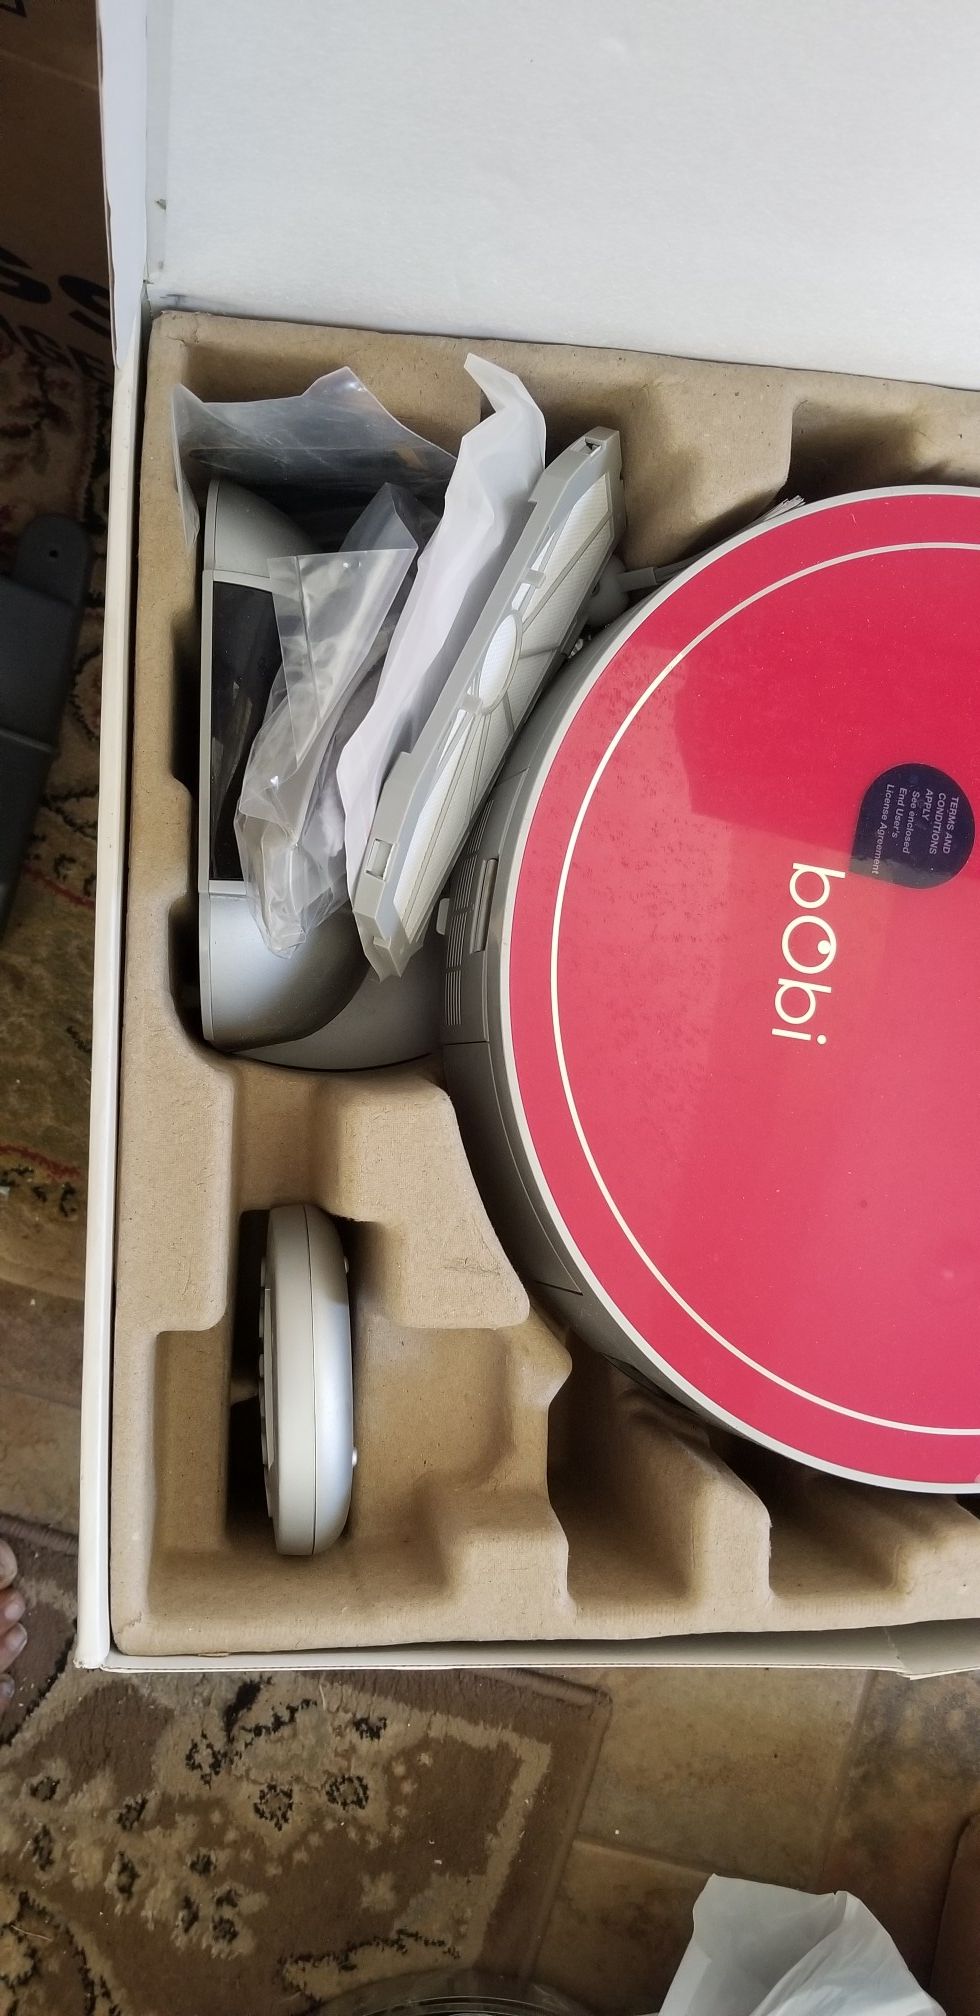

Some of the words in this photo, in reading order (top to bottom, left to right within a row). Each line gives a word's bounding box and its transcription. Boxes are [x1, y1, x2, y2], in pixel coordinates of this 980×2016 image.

[881, 784, 894, 821] License
[897, 787, 907, 807] End
[910, 790, 920, 809] See
[921, 788, 933, 821] APPLY
[946, 796, 959, 831] TERMS
[891, 808, 904, 838] User's
[902, 810, 915, 854] enclosed
[929, 792, 946, 855] CONDITIONS
[872, 822, 887, 875] Agreement
[942, 832, 953, 854] AND
